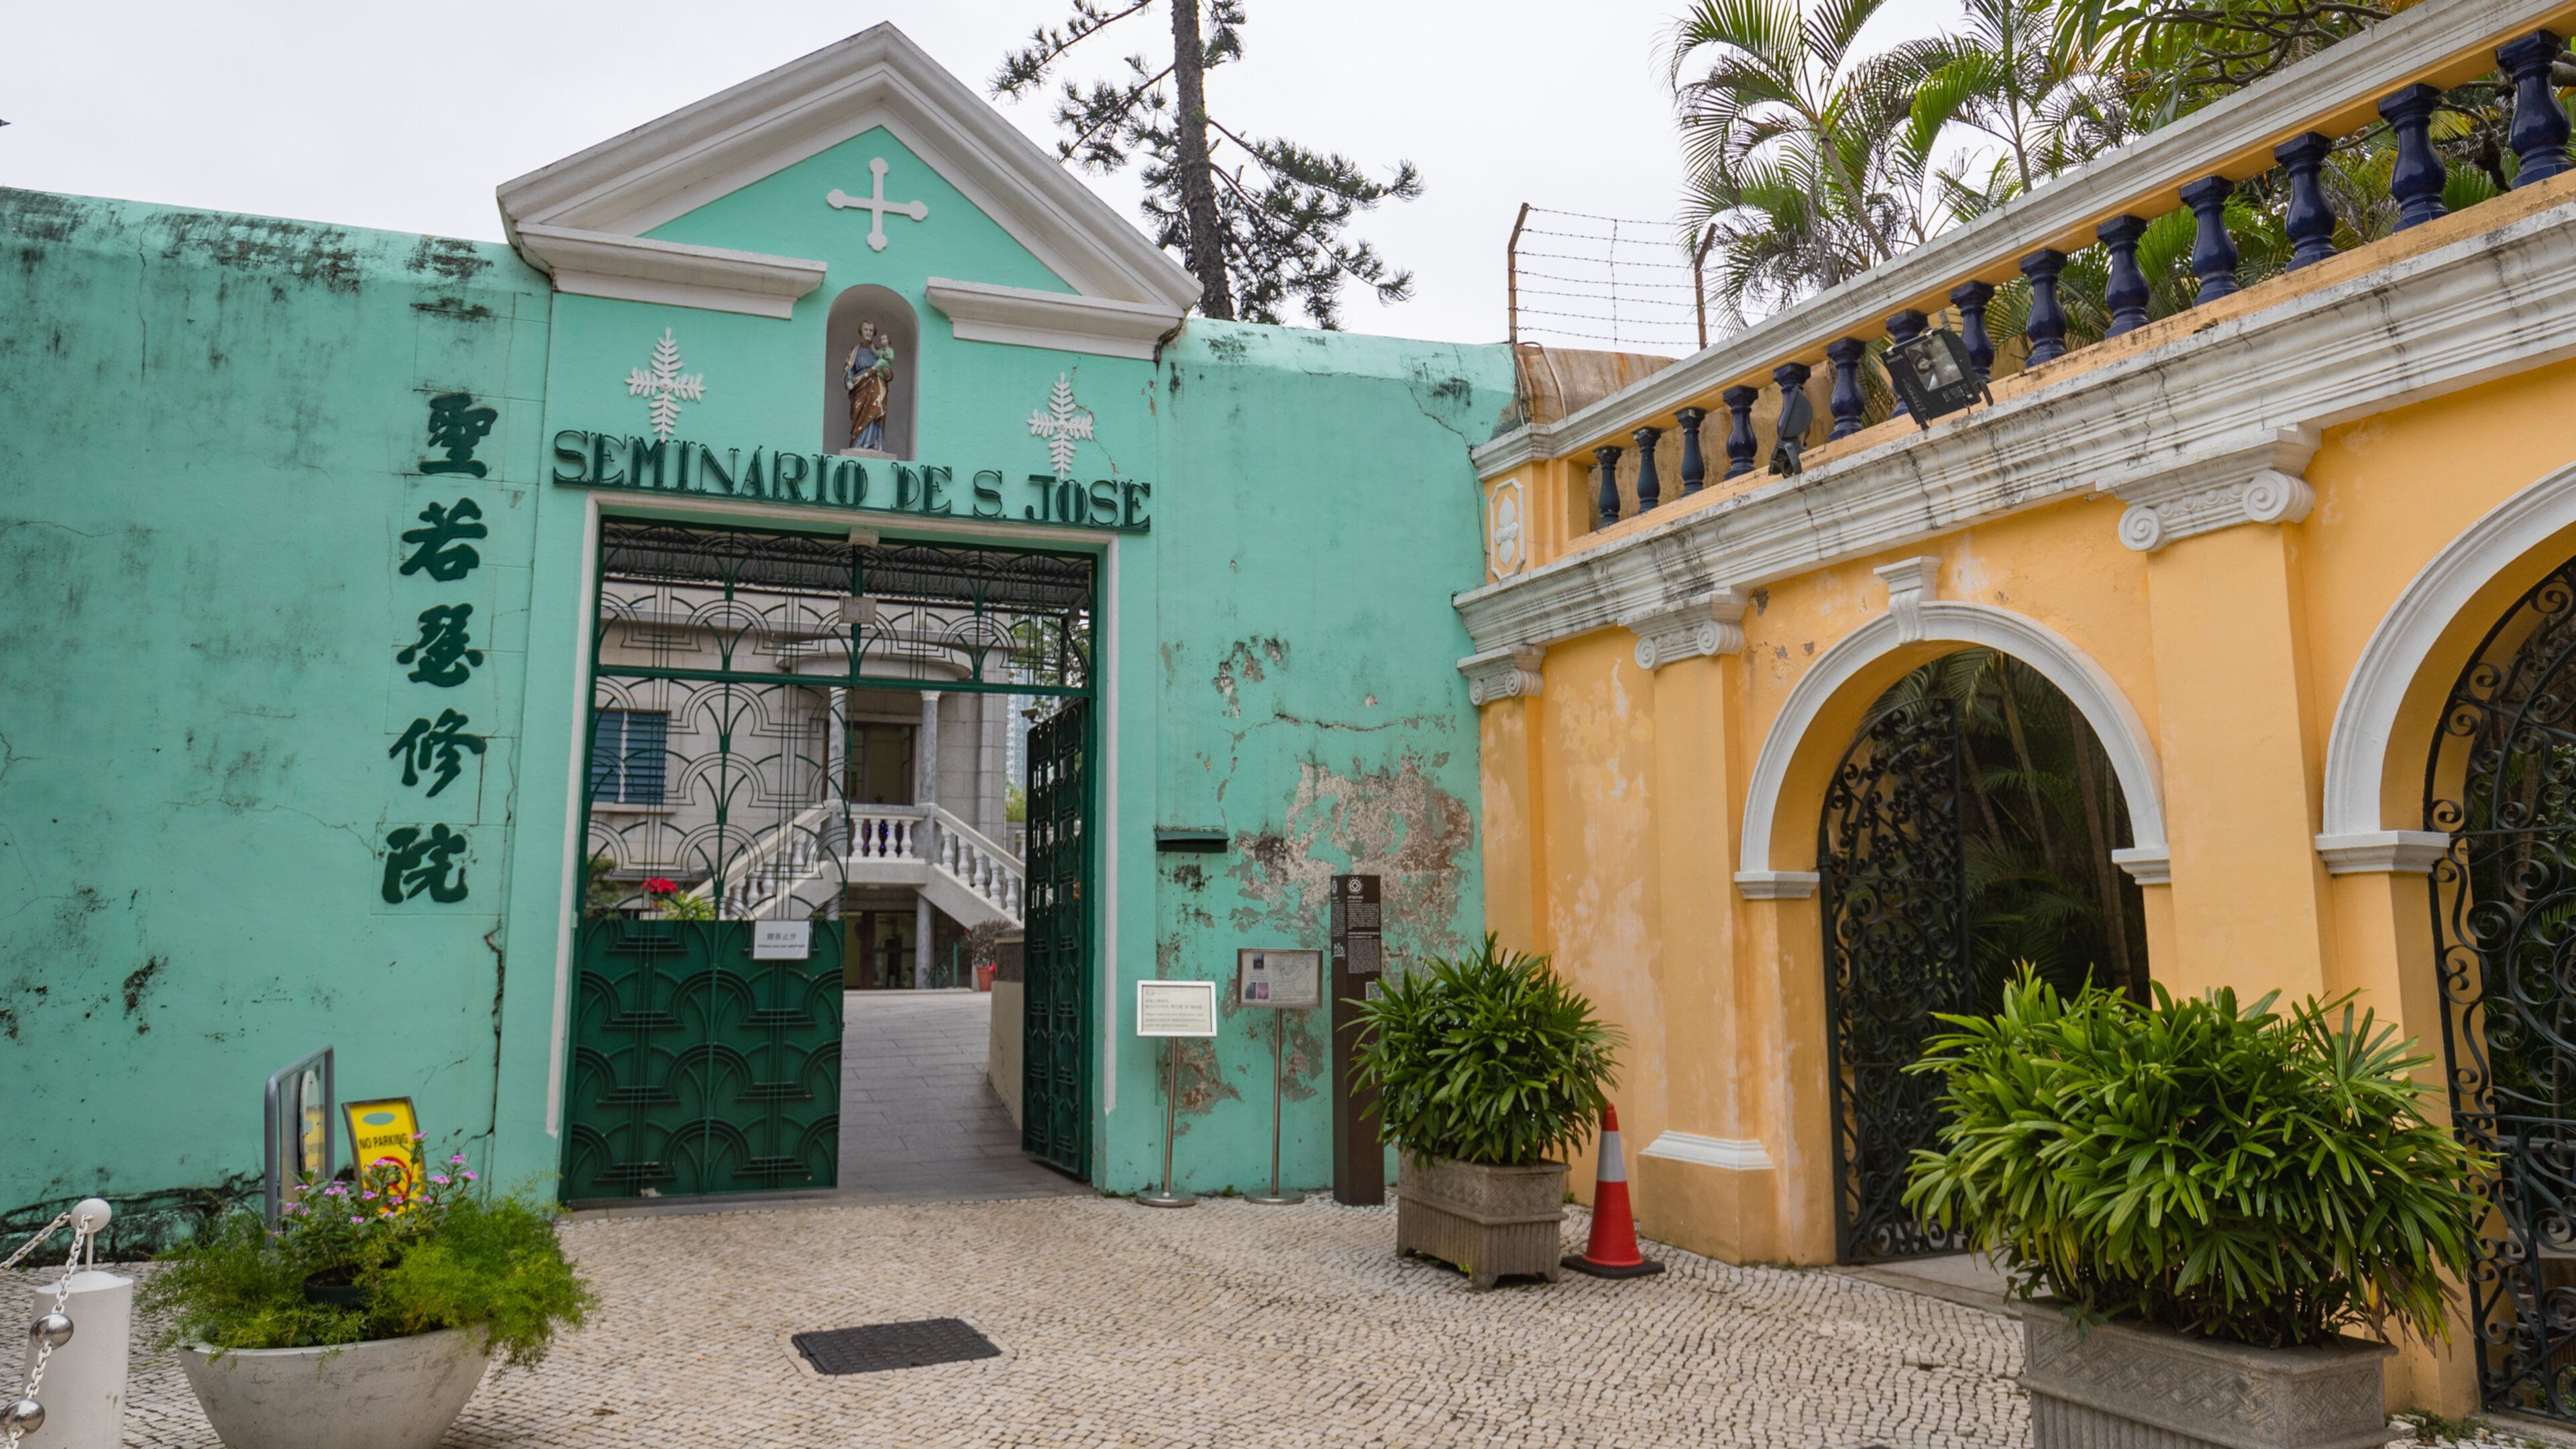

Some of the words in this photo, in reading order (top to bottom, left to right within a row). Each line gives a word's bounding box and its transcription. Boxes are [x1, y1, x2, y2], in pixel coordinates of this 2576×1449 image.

[553, 429, 868, 506] SEMINÁRIO
[890, 462, 953, 513] DE
[381, 392, 498, 904] 聖若瑟修院
[359, 1138, 372, 1149] NO
[373, 1133, 409, 1148] PARKING
